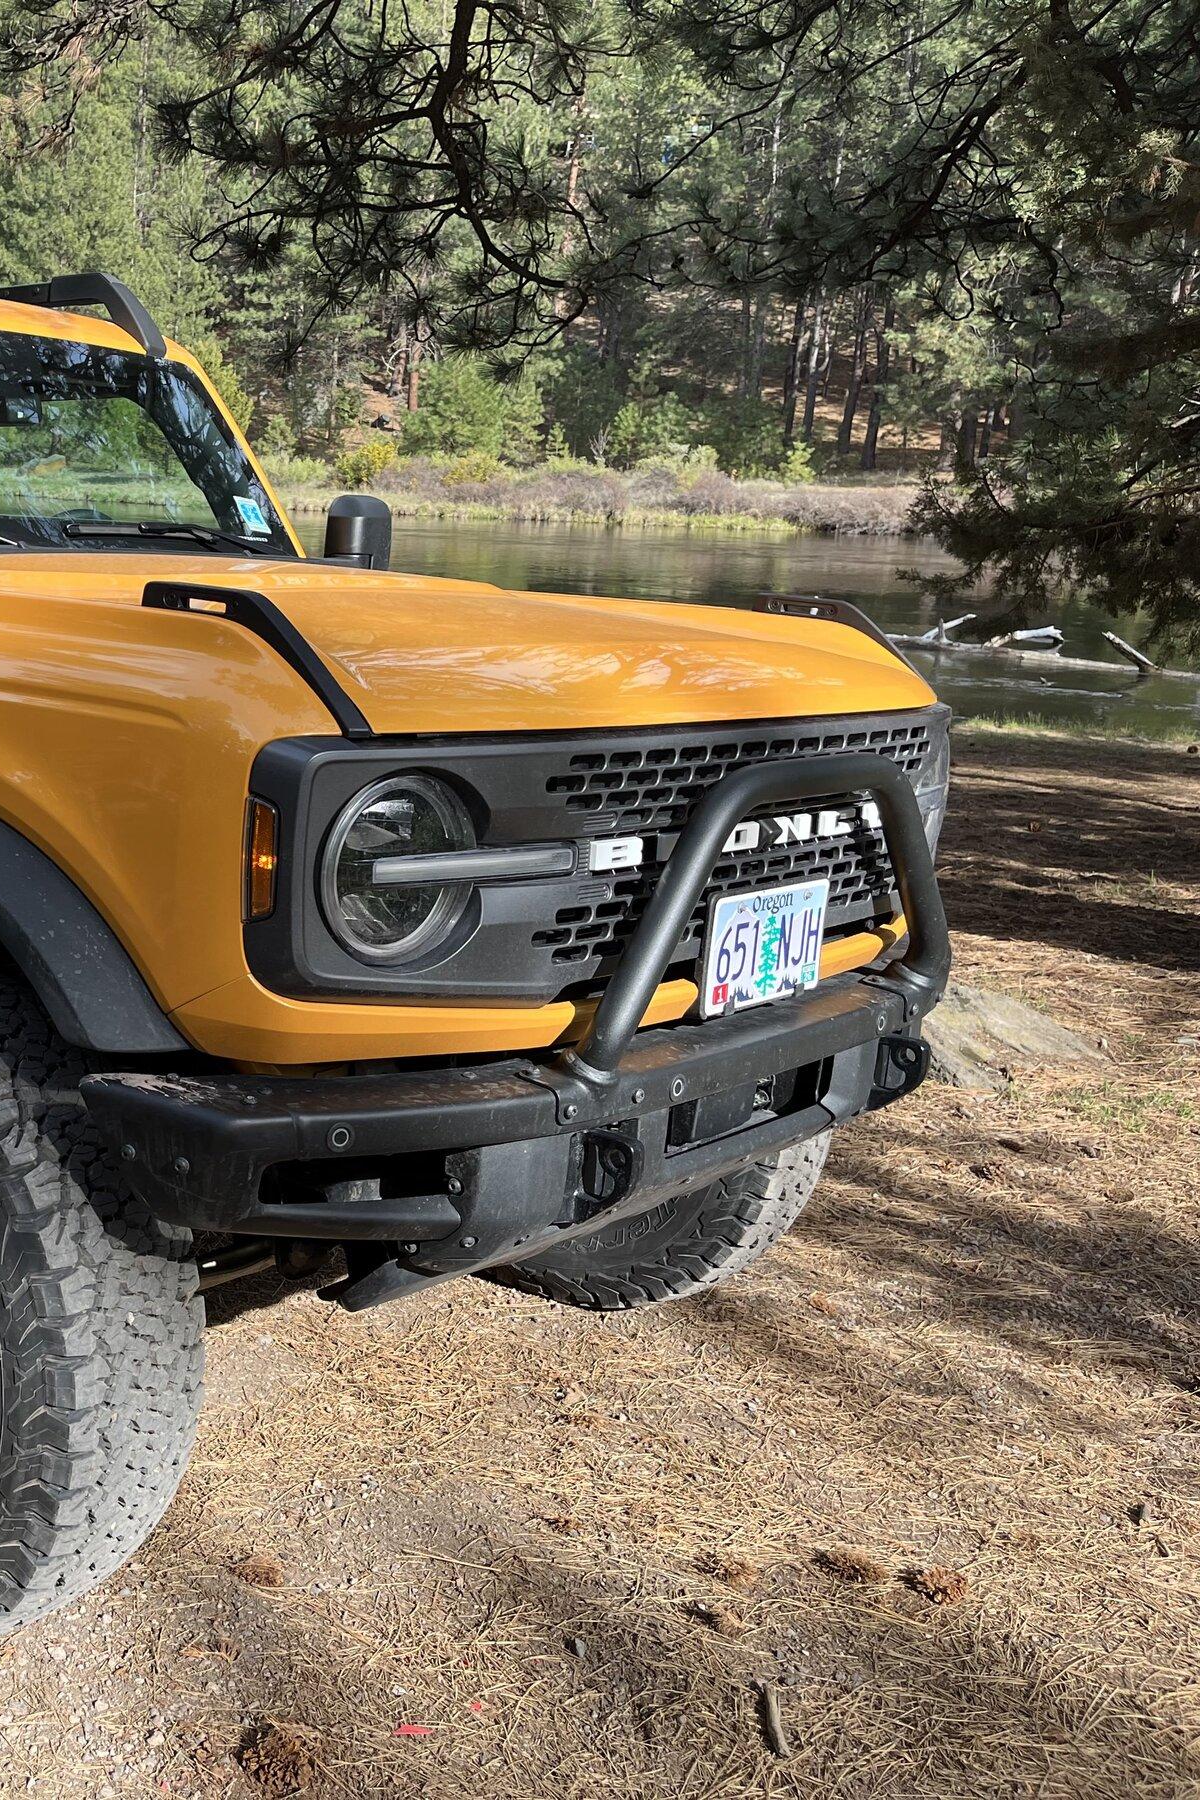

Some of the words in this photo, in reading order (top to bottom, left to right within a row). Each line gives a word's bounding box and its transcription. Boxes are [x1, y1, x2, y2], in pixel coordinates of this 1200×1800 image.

[752, 891, 794, 915] Oregon
[716, 919, 760, 984] 651
[775, 906, 822, 972] NJH
